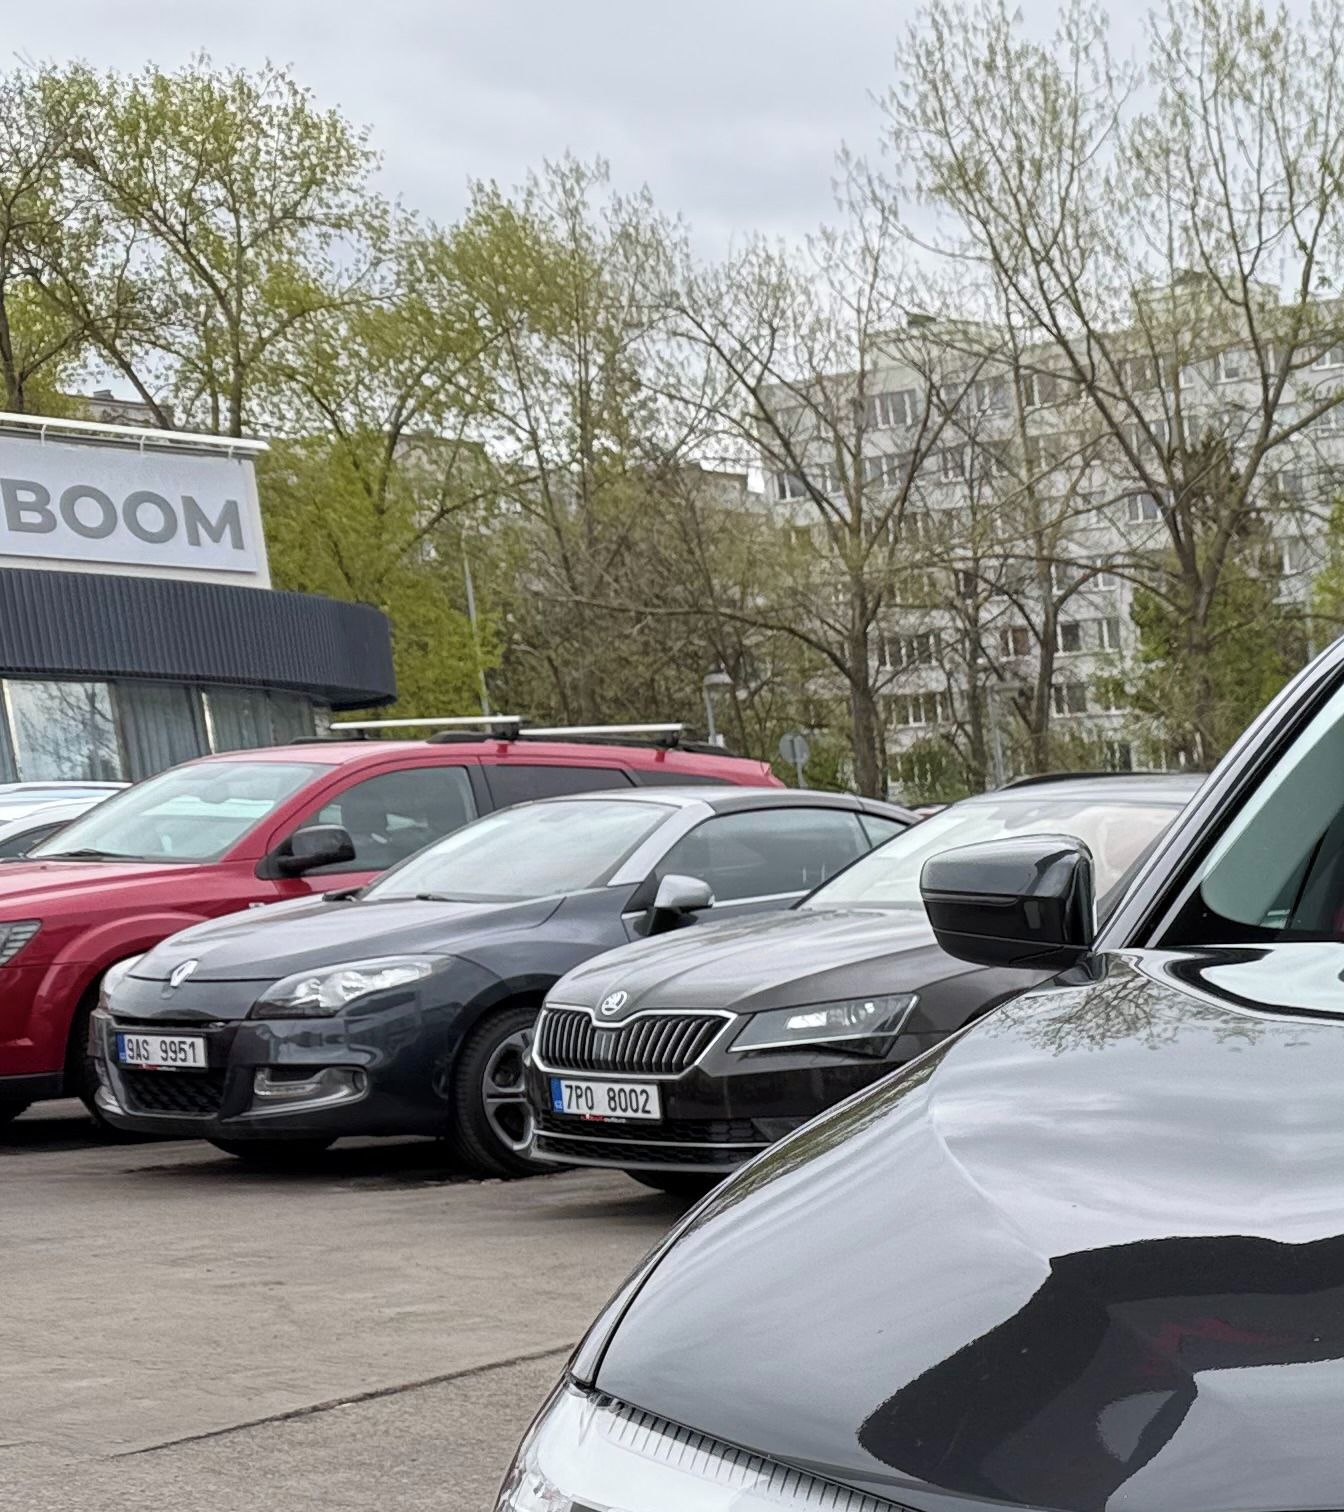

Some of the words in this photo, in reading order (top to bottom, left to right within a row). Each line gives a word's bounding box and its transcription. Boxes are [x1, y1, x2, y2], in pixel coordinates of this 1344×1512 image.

[0, 478, 245, 550] BOOM
[127, 1038, 150, 1060] 9AS
[160, 1039, 197, 1063] 9951
[607, 1087, 651, 1114] 8002
